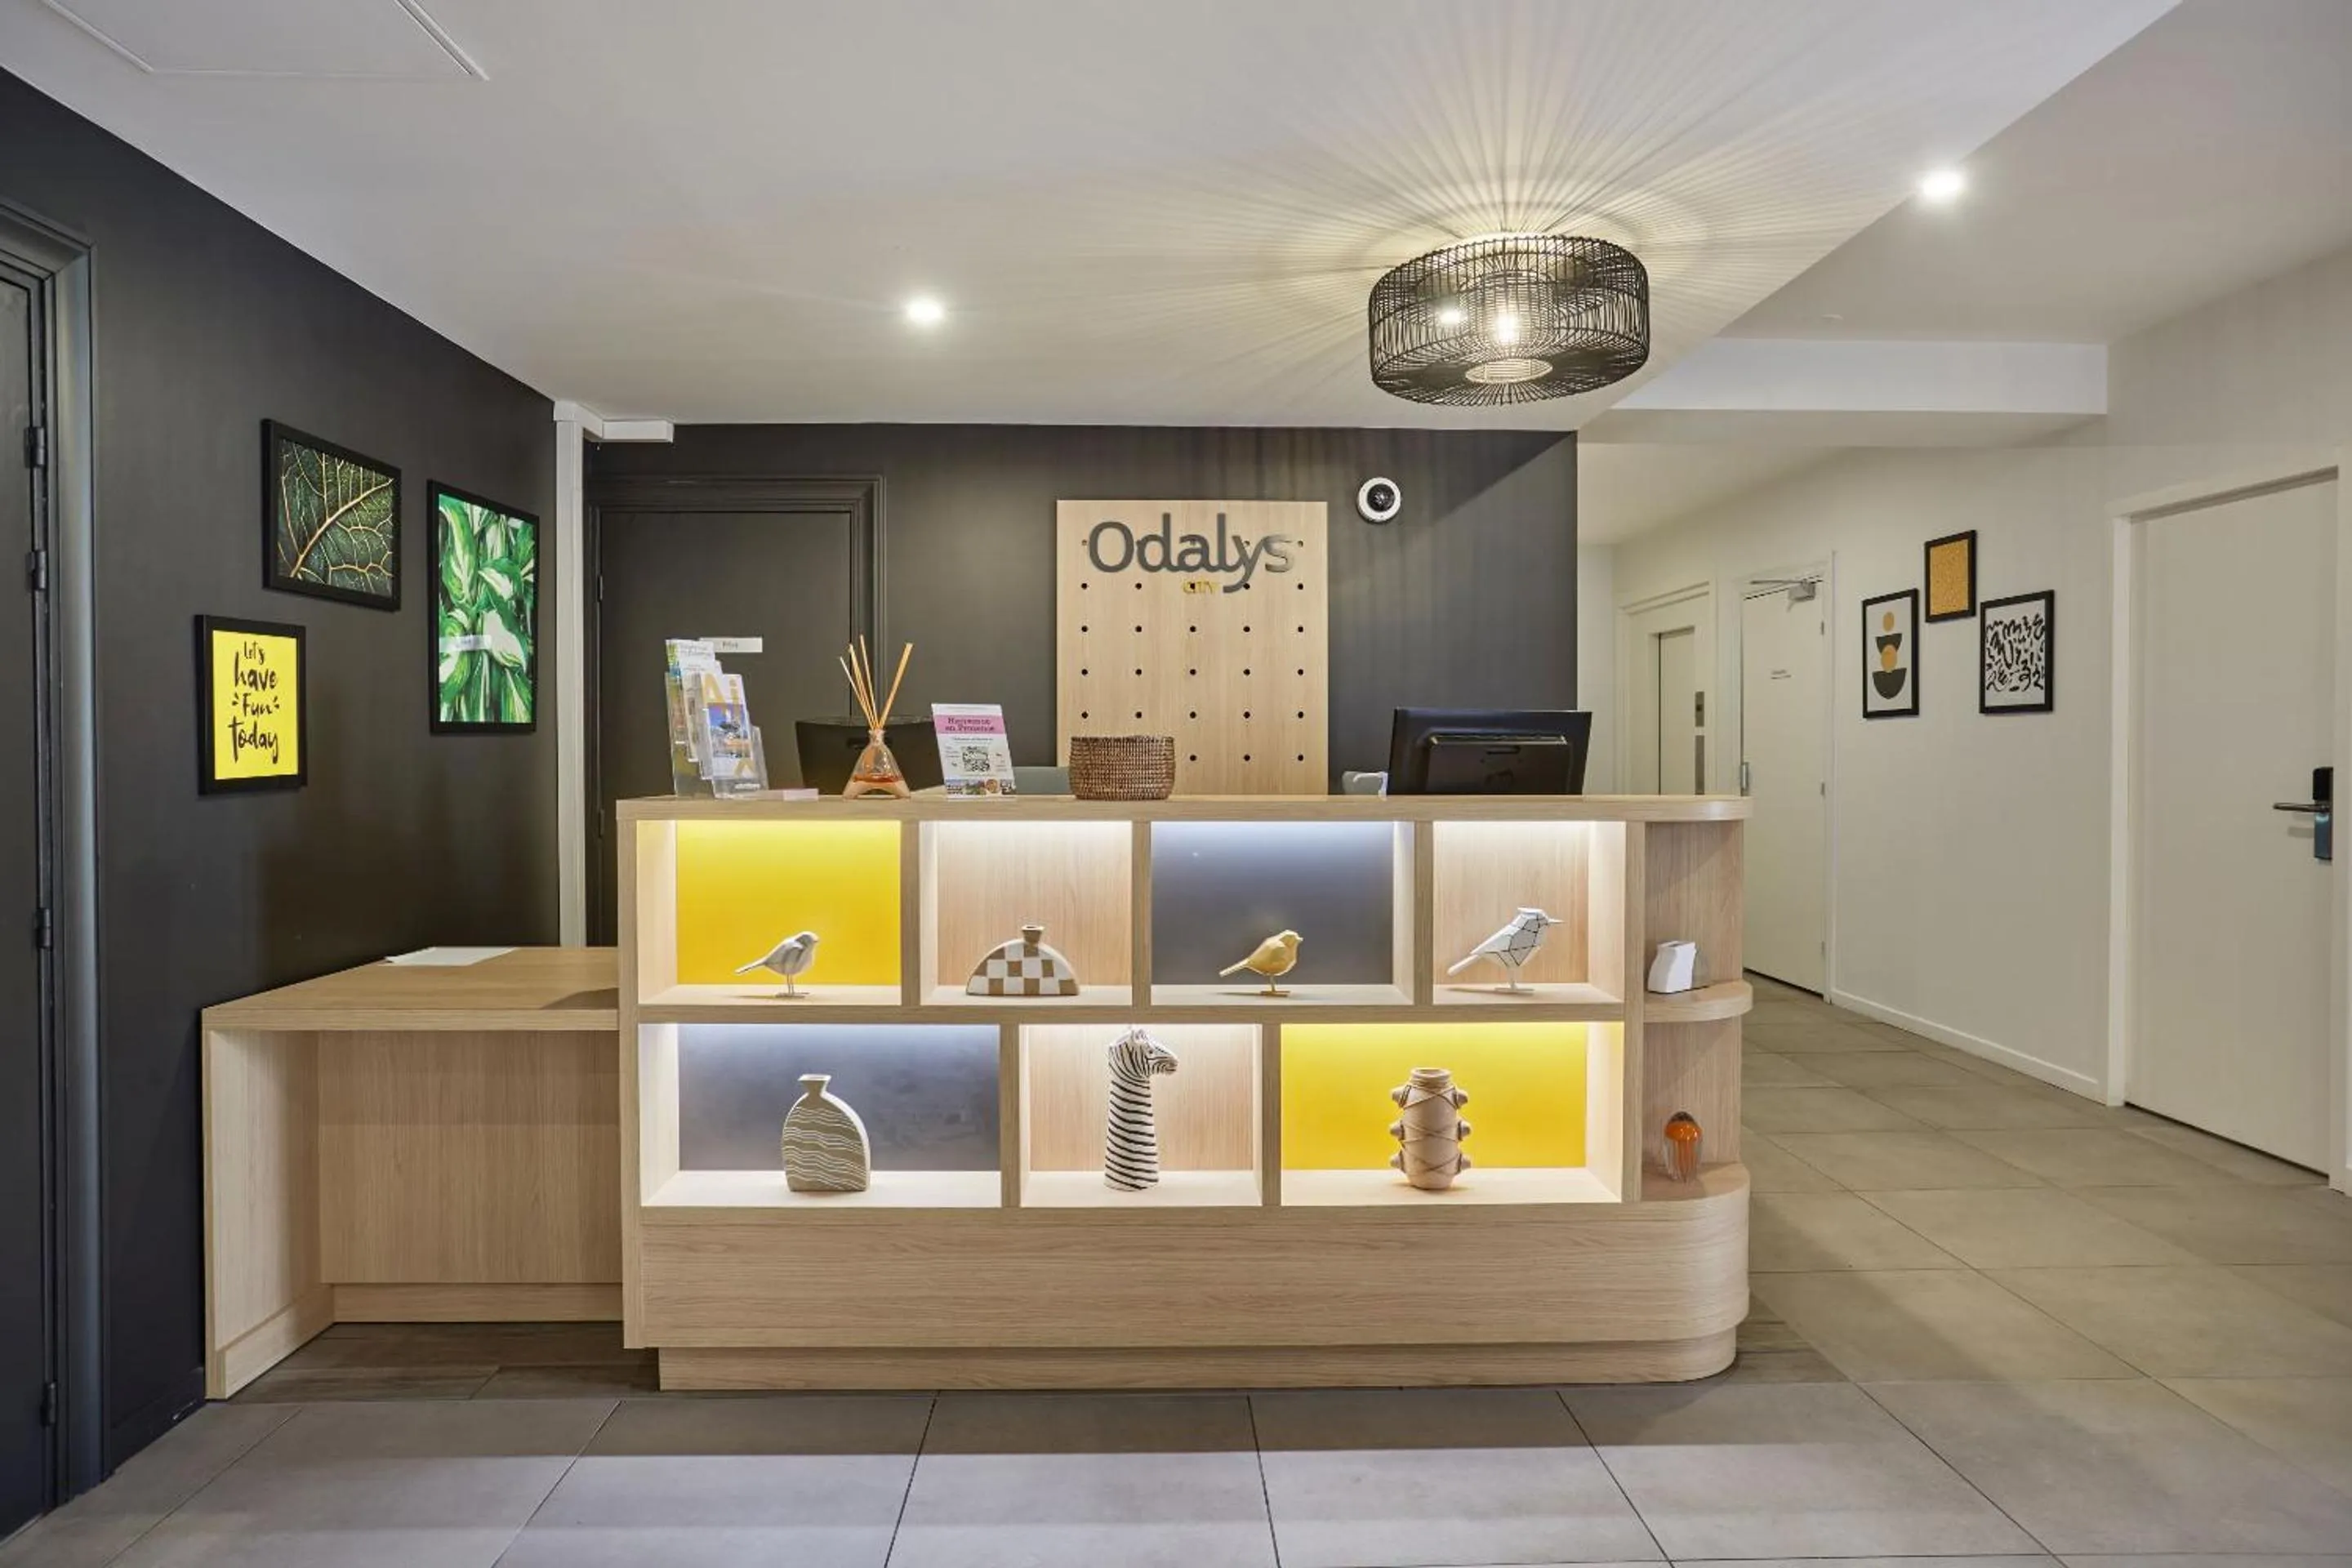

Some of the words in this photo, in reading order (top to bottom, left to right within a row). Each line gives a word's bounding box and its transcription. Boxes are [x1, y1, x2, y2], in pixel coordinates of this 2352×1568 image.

[1089, 513, 1294, 594] Odalys
[234, 651, 278, 691] have
[228, 716, 279, 764] today
